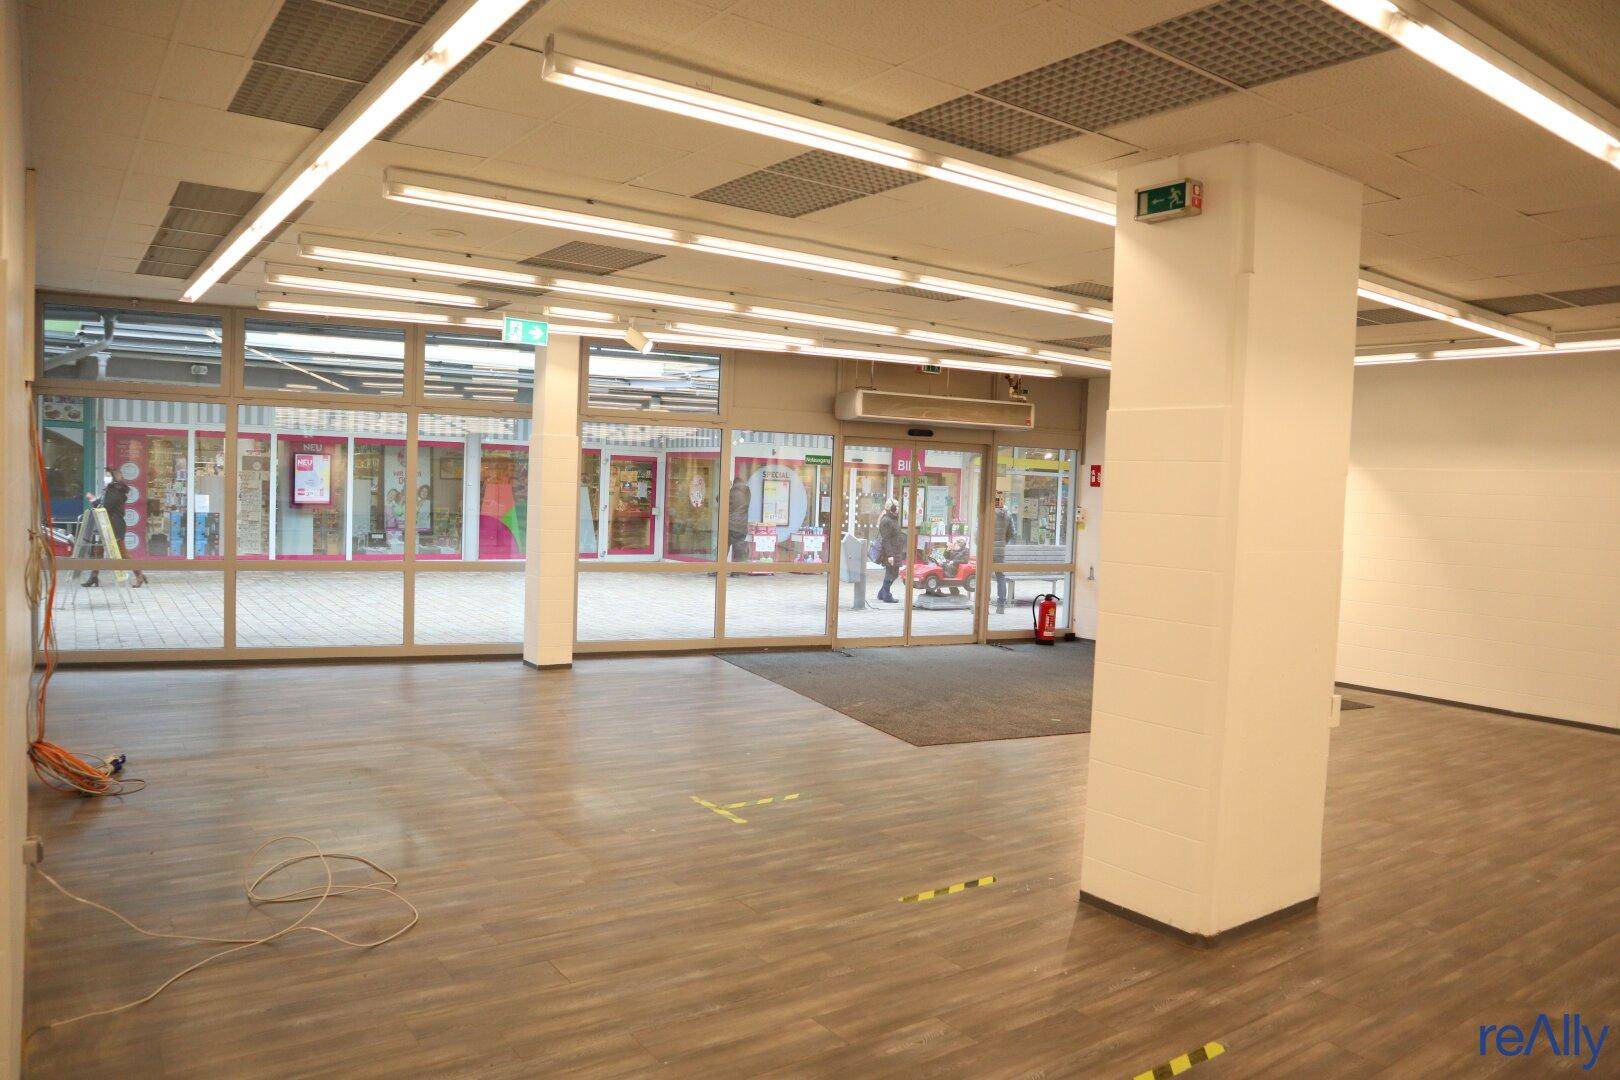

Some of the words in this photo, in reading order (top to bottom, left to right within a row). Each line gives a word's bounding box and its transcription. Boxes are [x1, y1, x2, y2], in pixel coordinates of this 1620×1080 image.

[303, 443, 322, 451] NEU
[898, 460, 922, 471] BIA
[762, 471, 790, 479] SPECIAL
